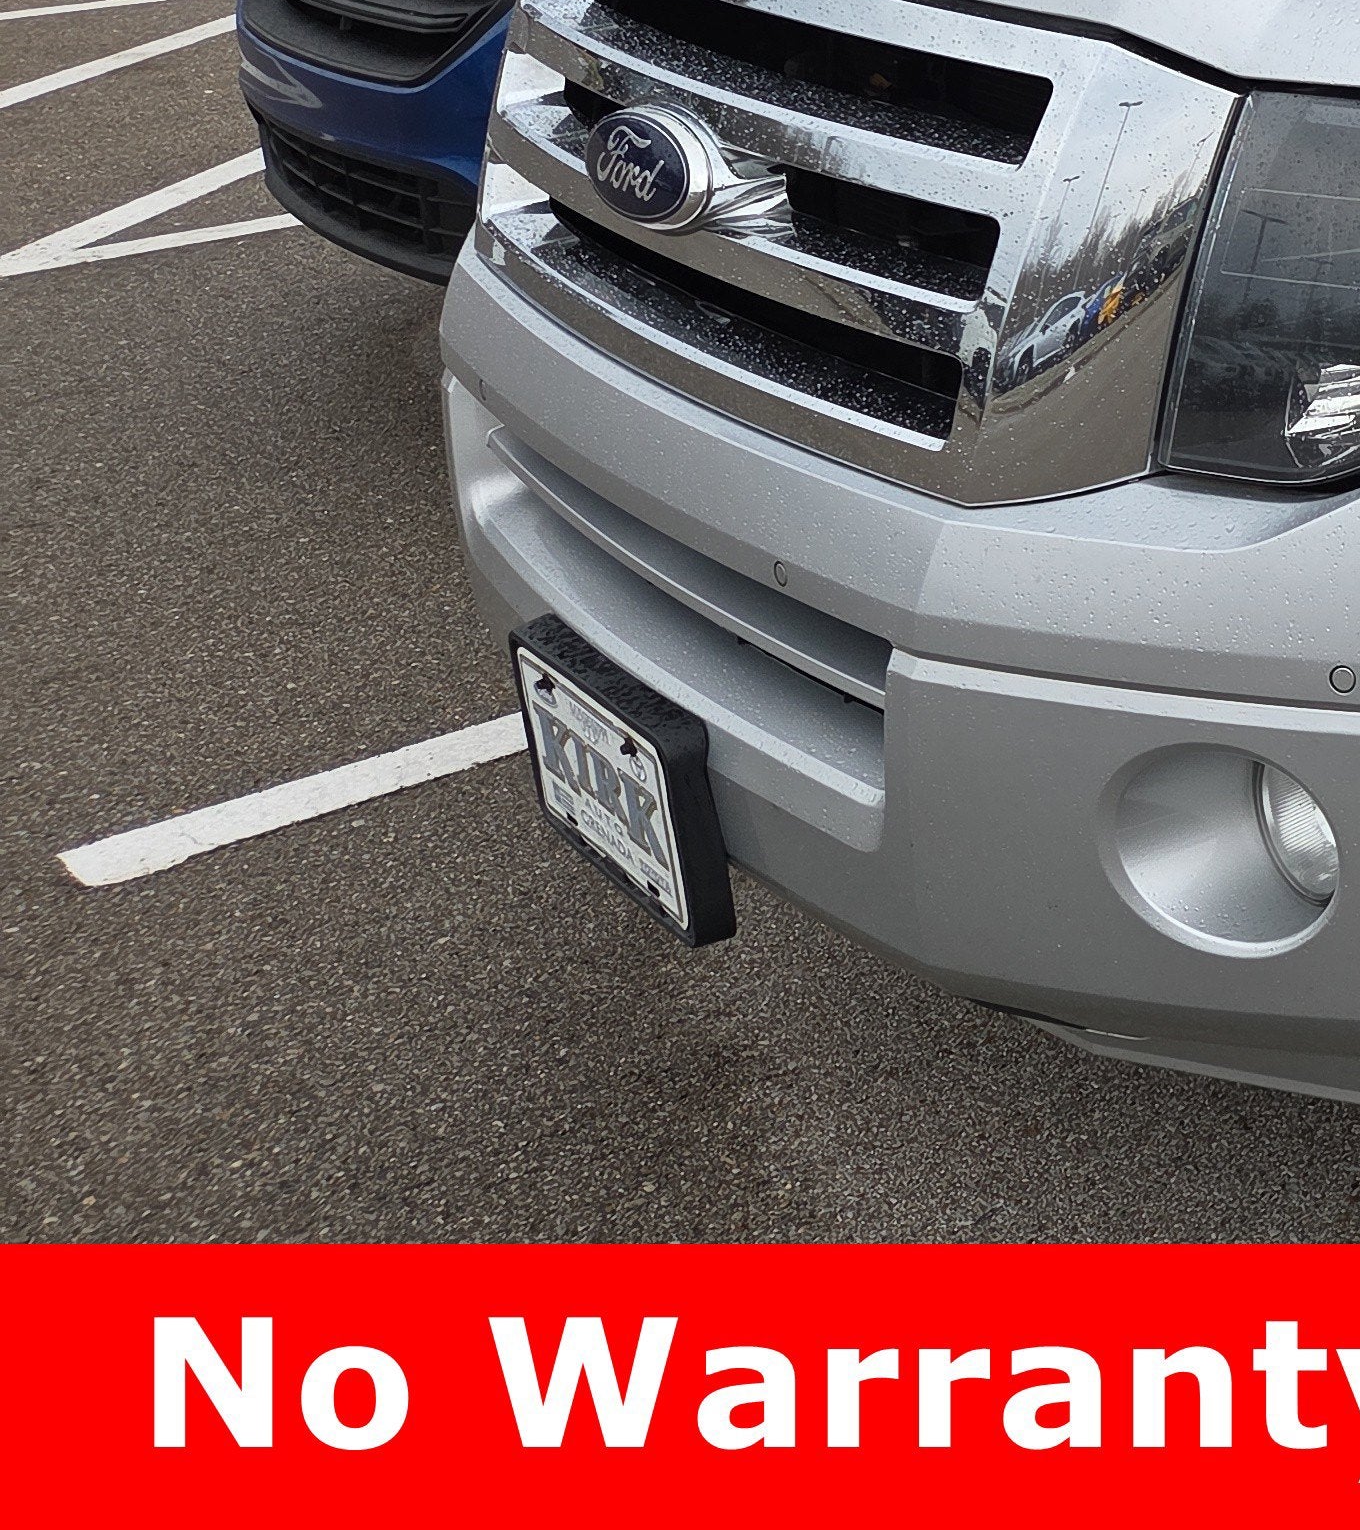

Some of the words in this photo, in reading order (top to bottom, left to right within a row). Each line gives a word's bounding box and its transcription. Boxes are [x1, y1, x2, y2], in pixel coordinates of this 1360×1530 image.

[596, 125, 665, 203] Ford
[531, 699, 671, 872] KIRK
[584, 797, 624, 837] AUTO
[580, 808, 636, 866] GRENADA
